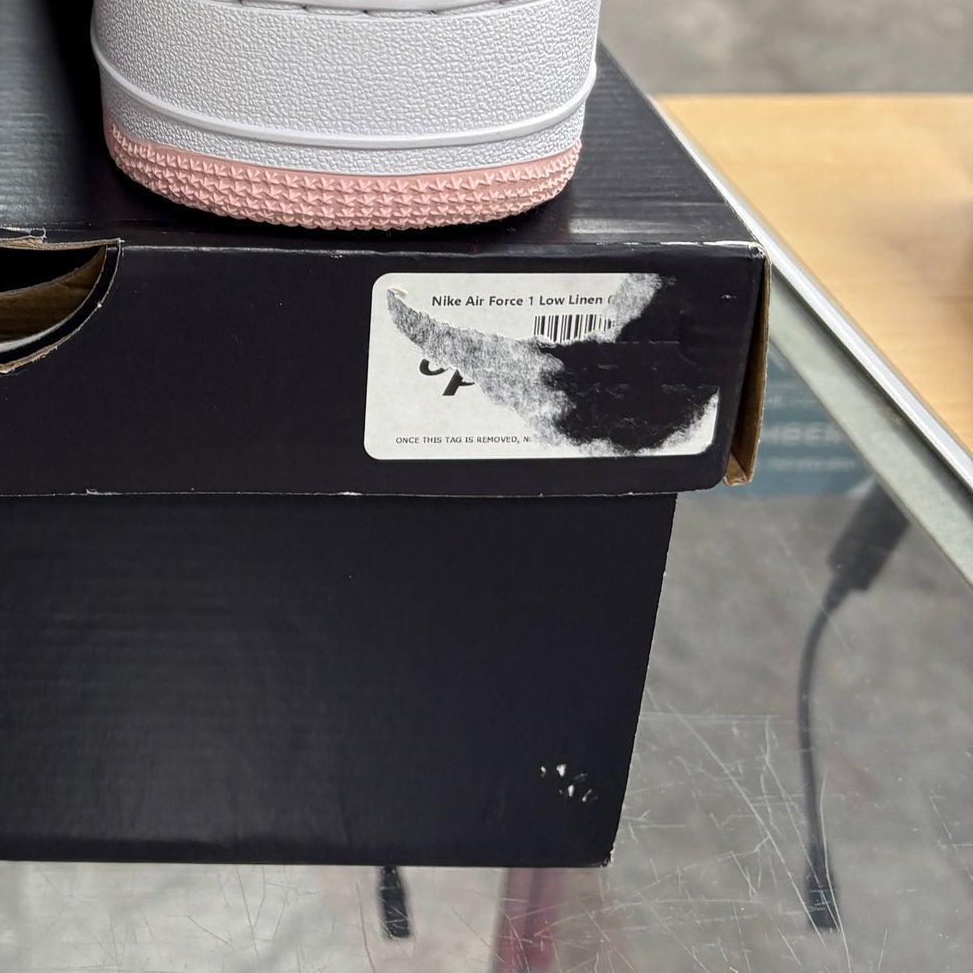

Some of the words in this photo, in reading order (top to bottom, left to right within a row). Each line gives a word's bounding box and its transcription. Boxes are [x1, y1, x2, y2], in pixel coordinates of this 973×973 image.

[431, 296, 462, 307] Nike
[465, 296, 485, 307] Air
[489, 296, 524, 307] Force
[528, 296, 535, 306] 1
[539, 295, 565, 306] Low
[568, 294, 603, 306] Linen
[395, 436, 420, 444] ONCE
[423, 436, 443, 444] THIS
[445, 436, 462, 444] TAG
[465, 436, 474, 444] IS
[476, 436, 520, 444] REMOVED,
